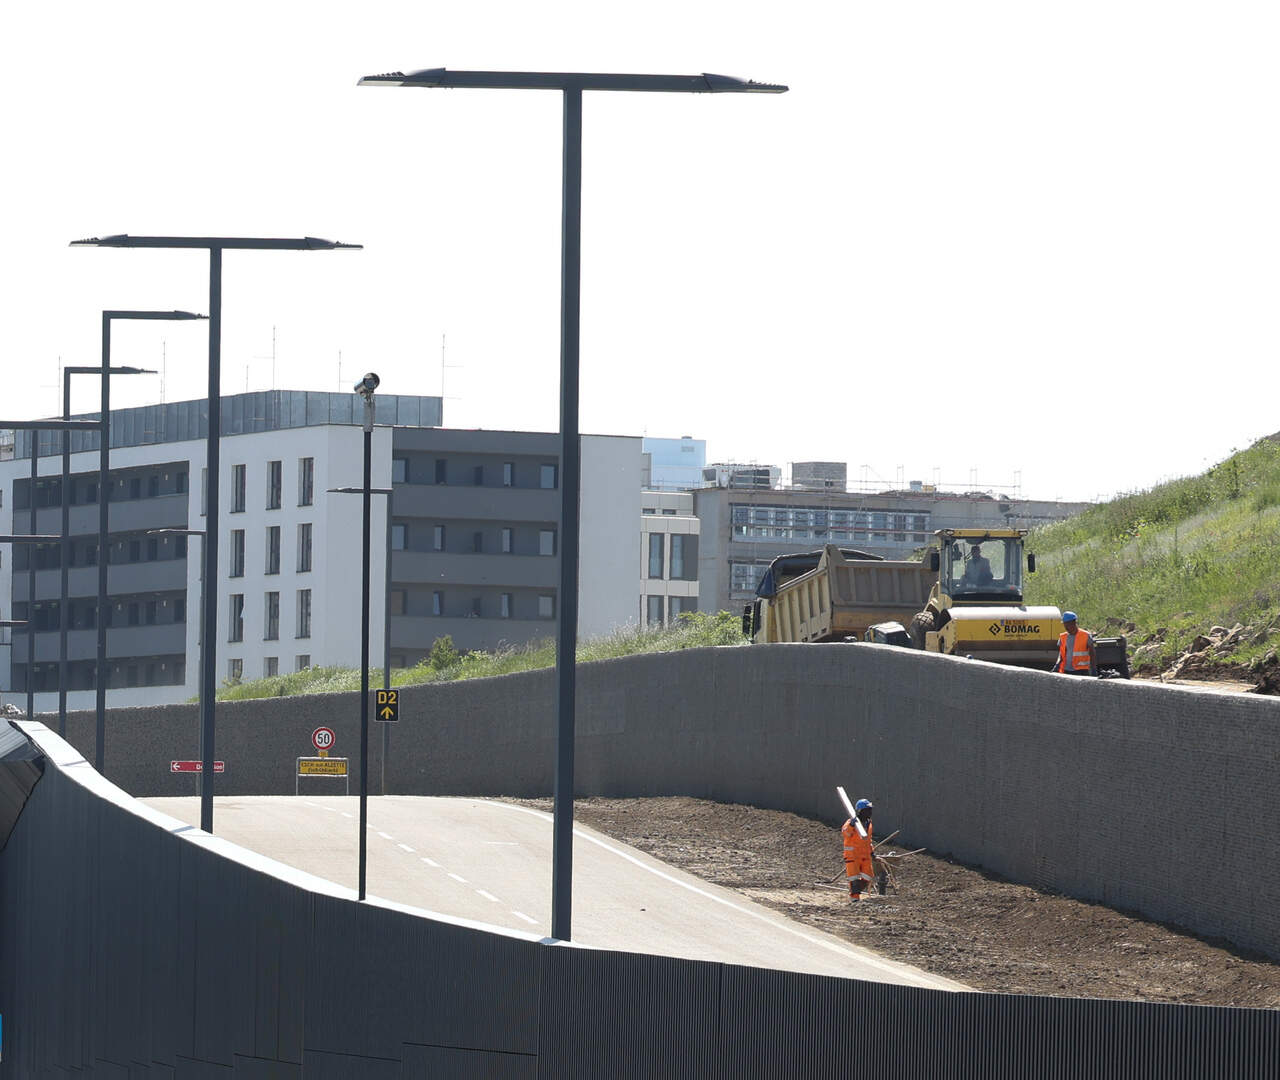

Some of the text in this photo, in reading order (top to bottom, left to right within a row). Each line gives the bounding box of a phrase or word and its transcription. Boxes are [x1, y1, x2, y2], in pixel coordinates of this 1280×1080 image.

[1004, 625, 1040, 633] BOMAG
[377, 691, 397, 704] D2
[317, 733, 330, 744] 50
